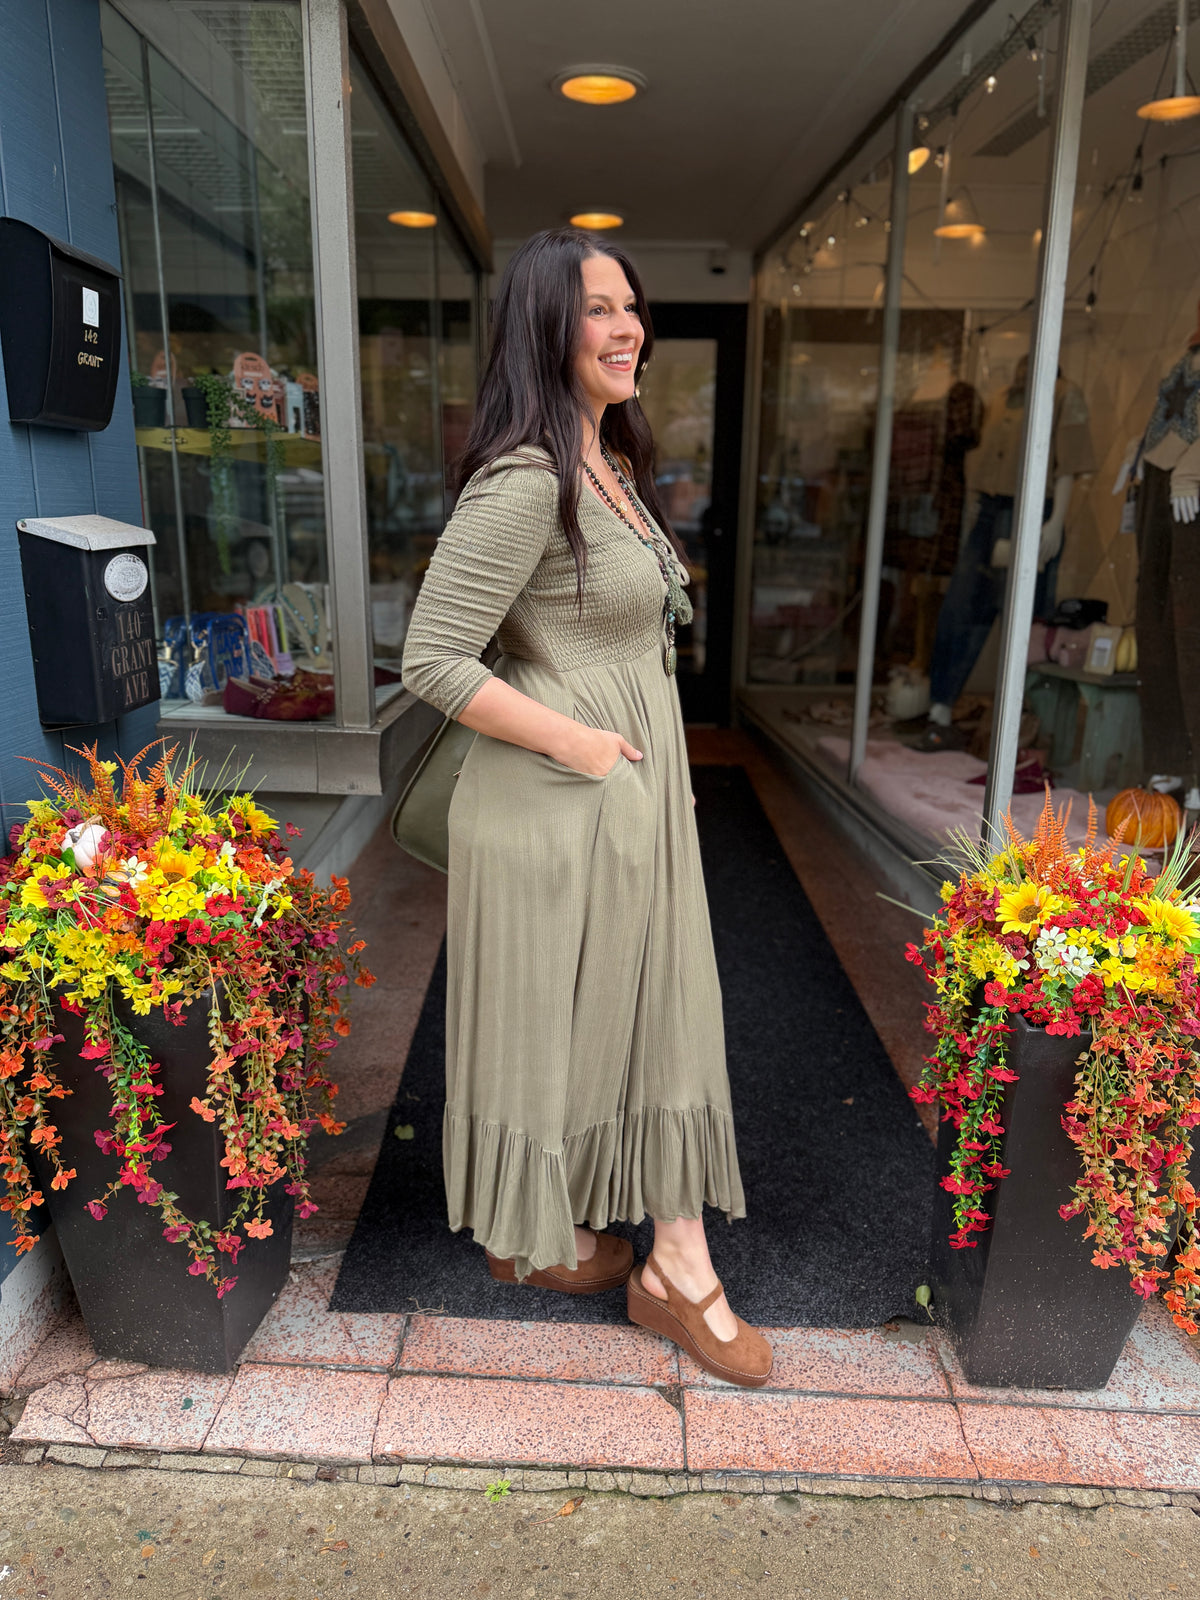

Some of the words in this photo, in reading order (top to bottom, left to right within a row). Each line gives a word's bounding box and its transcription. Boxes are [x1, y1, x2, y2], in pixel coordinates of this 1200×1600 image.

[84, 329, 98, 344] 142
[77, 351, 104, 368] GRANT
[117, 610, 141, 642] 140
[112, 639, 152, 677] GRANT
[125, 671, 149, 705] AVE
